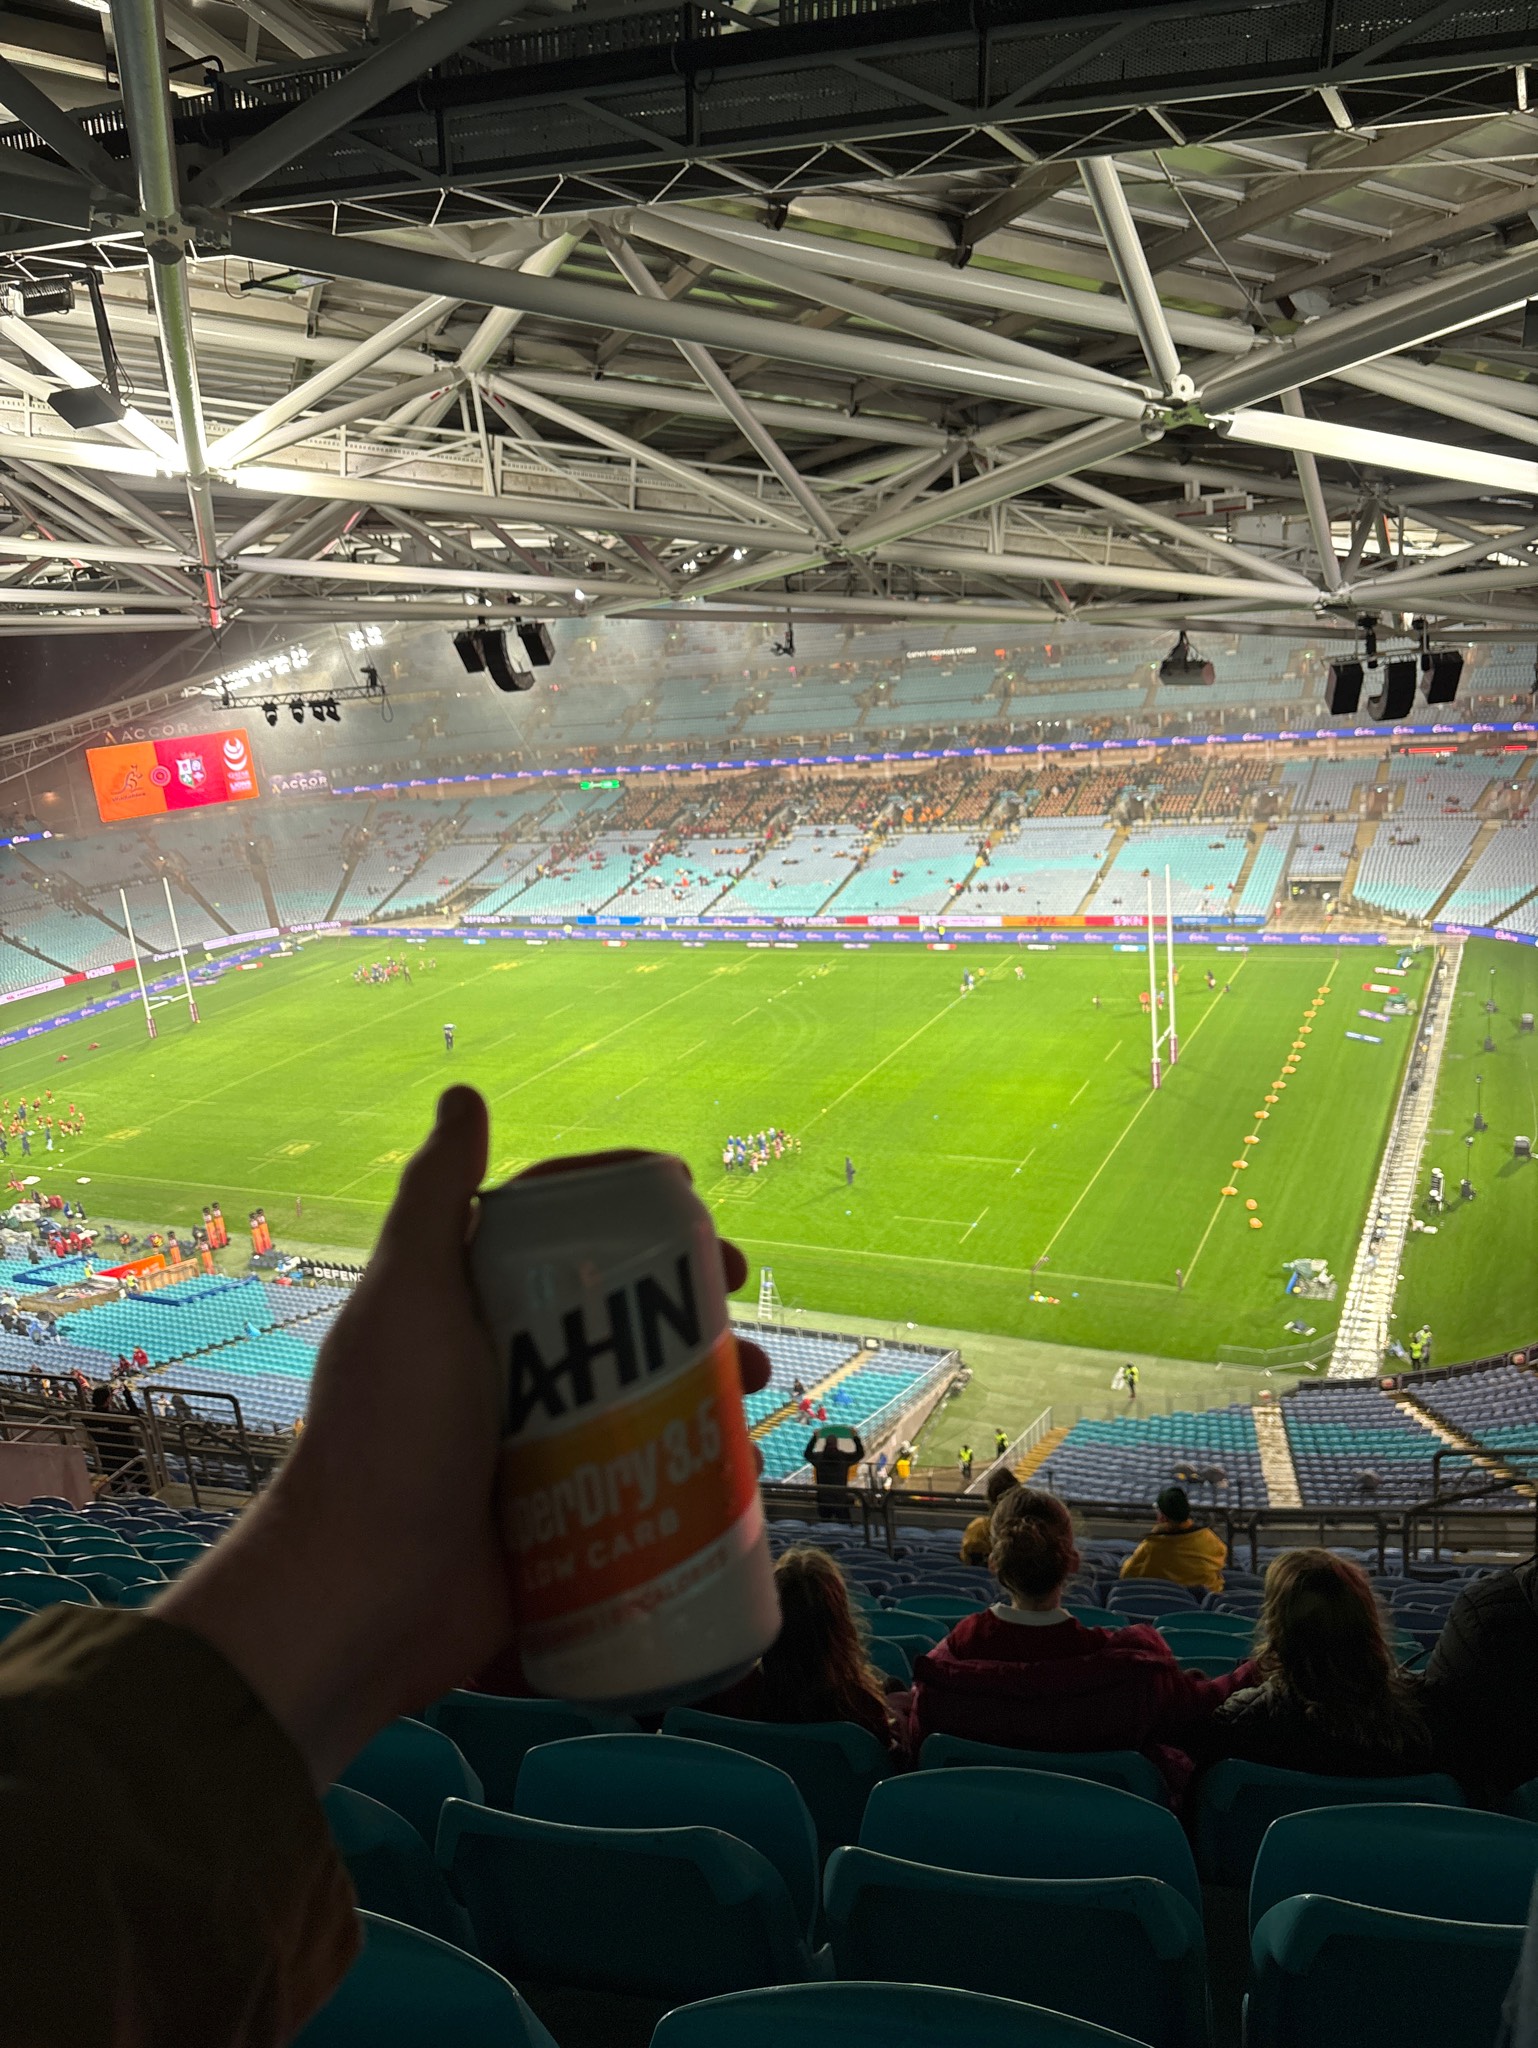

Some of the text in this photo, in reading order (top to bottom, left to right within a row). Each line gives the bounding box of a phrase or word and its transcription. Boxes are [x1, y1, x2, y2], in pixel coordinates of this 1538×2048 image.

[122, 722, 189, 743] ACCOR
[281, 776, 327, 790] ACCOR
[313, 1266, 365, 1283] DEFEND
[500, 1251, 702, 1441] AHN
[508, 1396, 721, 1553] perDry 3.5
[586, 1506, 680, 1570] CARB
